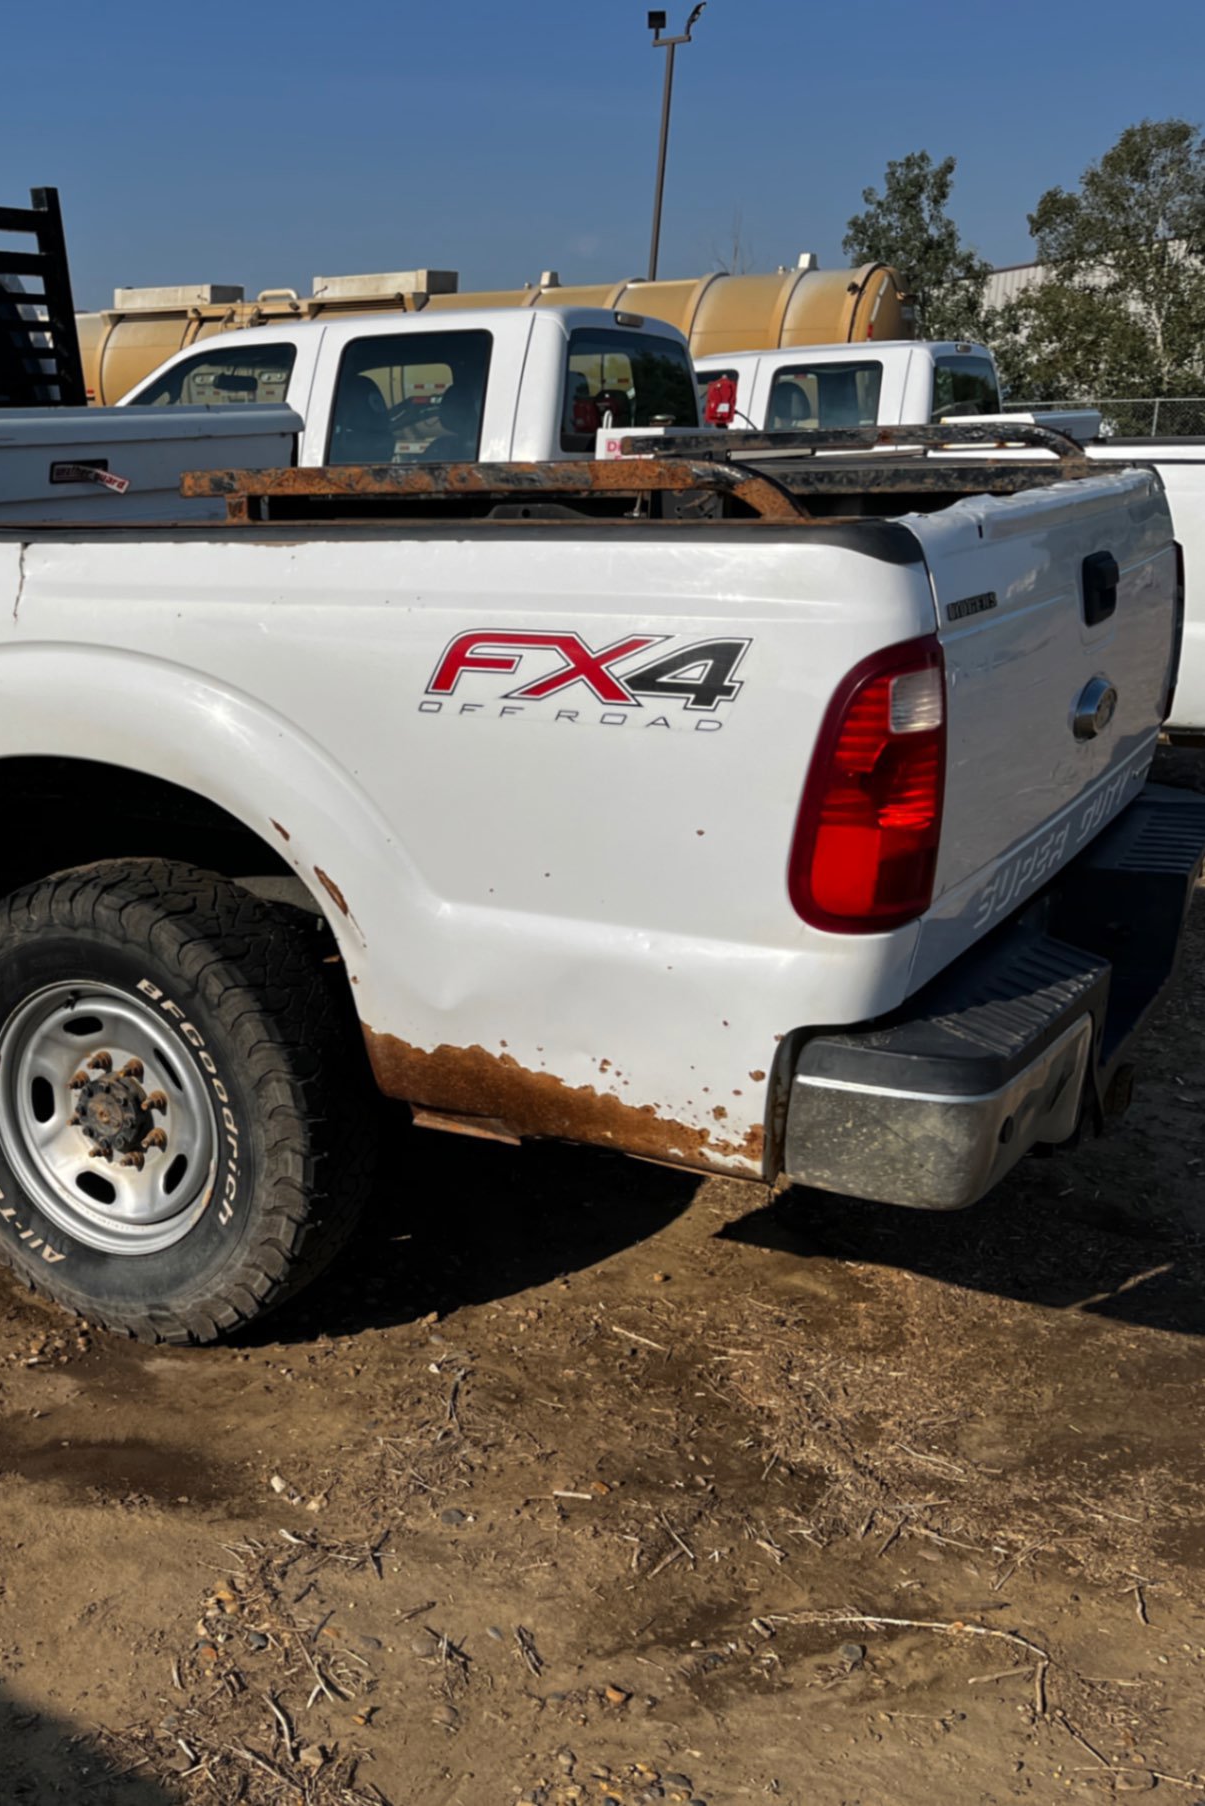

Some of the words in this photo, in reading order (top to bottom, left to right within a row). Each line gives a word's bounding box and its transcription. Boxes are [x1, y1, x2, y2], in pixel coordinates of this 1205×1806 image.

[418, 700, 525, 718] OFF
[554, 710, 723, 732] ROAD
[424, 628, 754, 712] FX4
[974, 822, 1071, 930] SUPER
[1076, 766, 1132, 844] DUTY
[136, 978, 241, 1226] BFGoodrich
